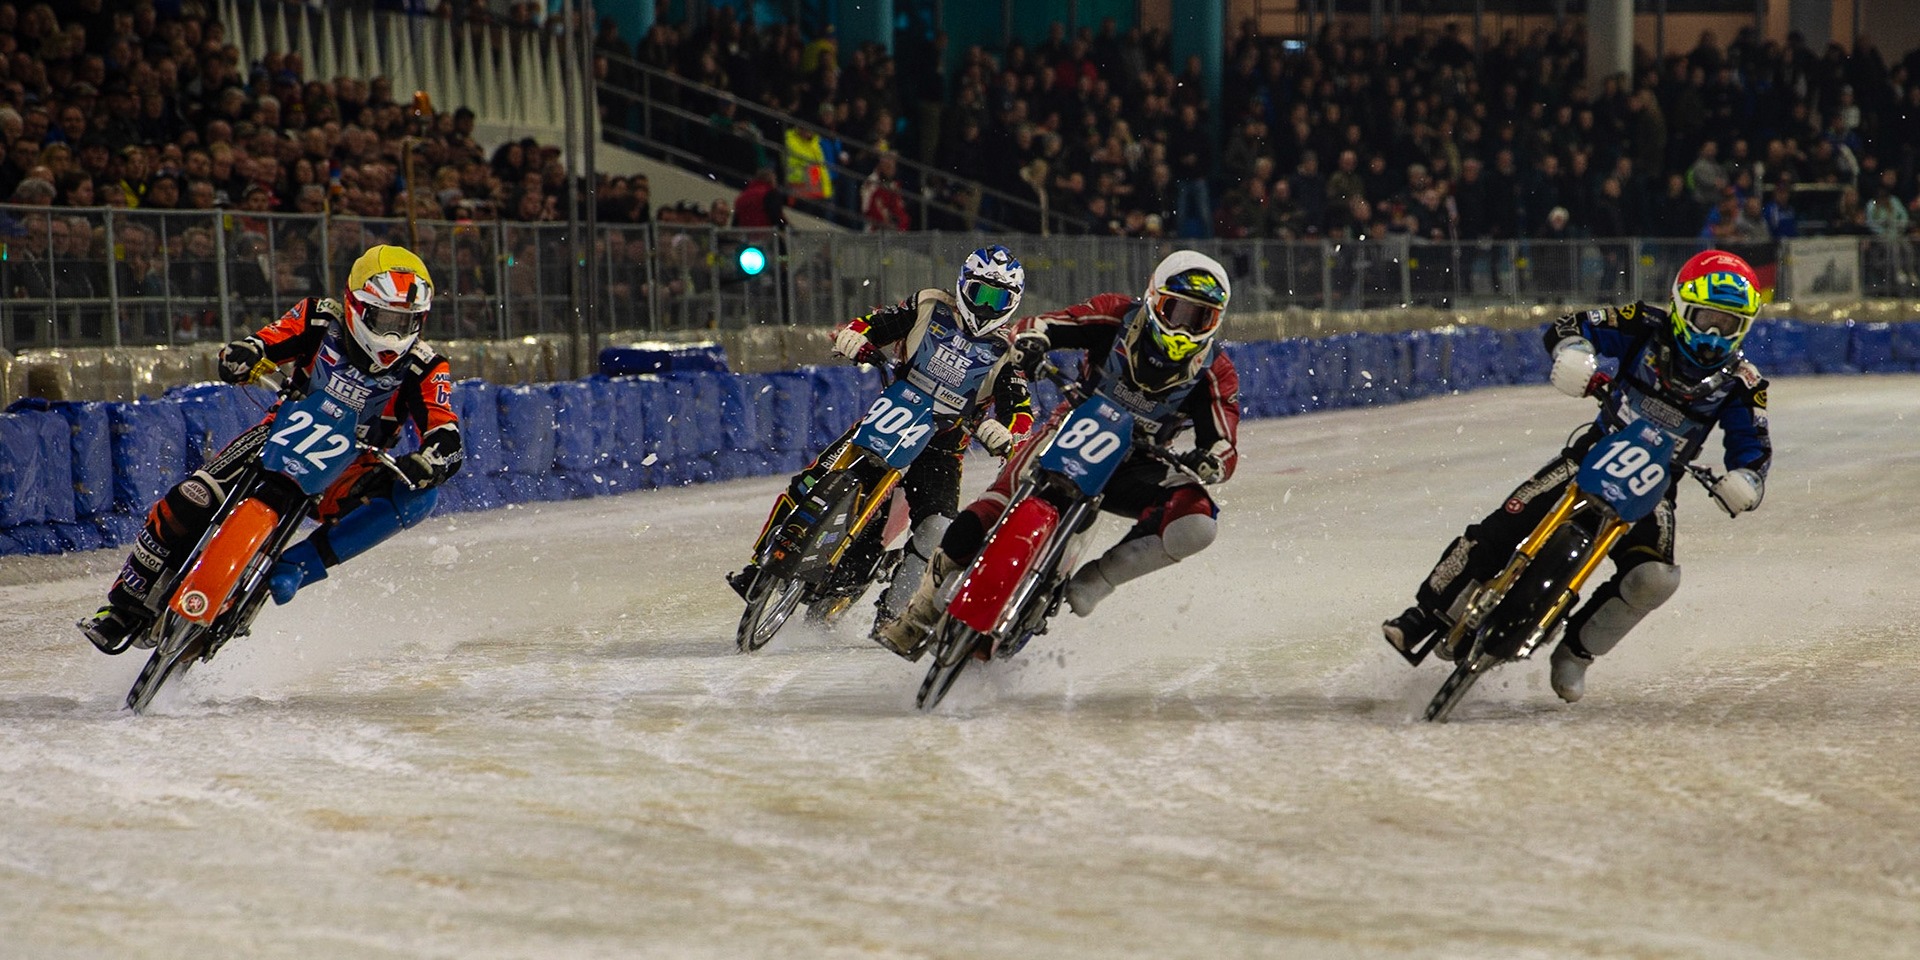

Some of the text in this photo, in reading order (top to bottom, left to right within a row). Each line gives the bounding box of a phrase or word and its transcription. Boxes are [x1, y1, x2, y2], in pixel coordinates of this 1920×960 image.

[933, 344, 973, 373] ICE
[950, 335, 973, 354] 904
[328, 372, 372, 403] ICE
[926, 361, 963, 388] GLADIATORS
[940, 389, 964, 405] Hertz
[861, 397, 931, 449] 904
[269, 410, 350, 471] 212
[1057, 418, 1121, 464] 80
[1591, 440, 1665, 496] 199
[187, 483, 207, 500] JAWA
